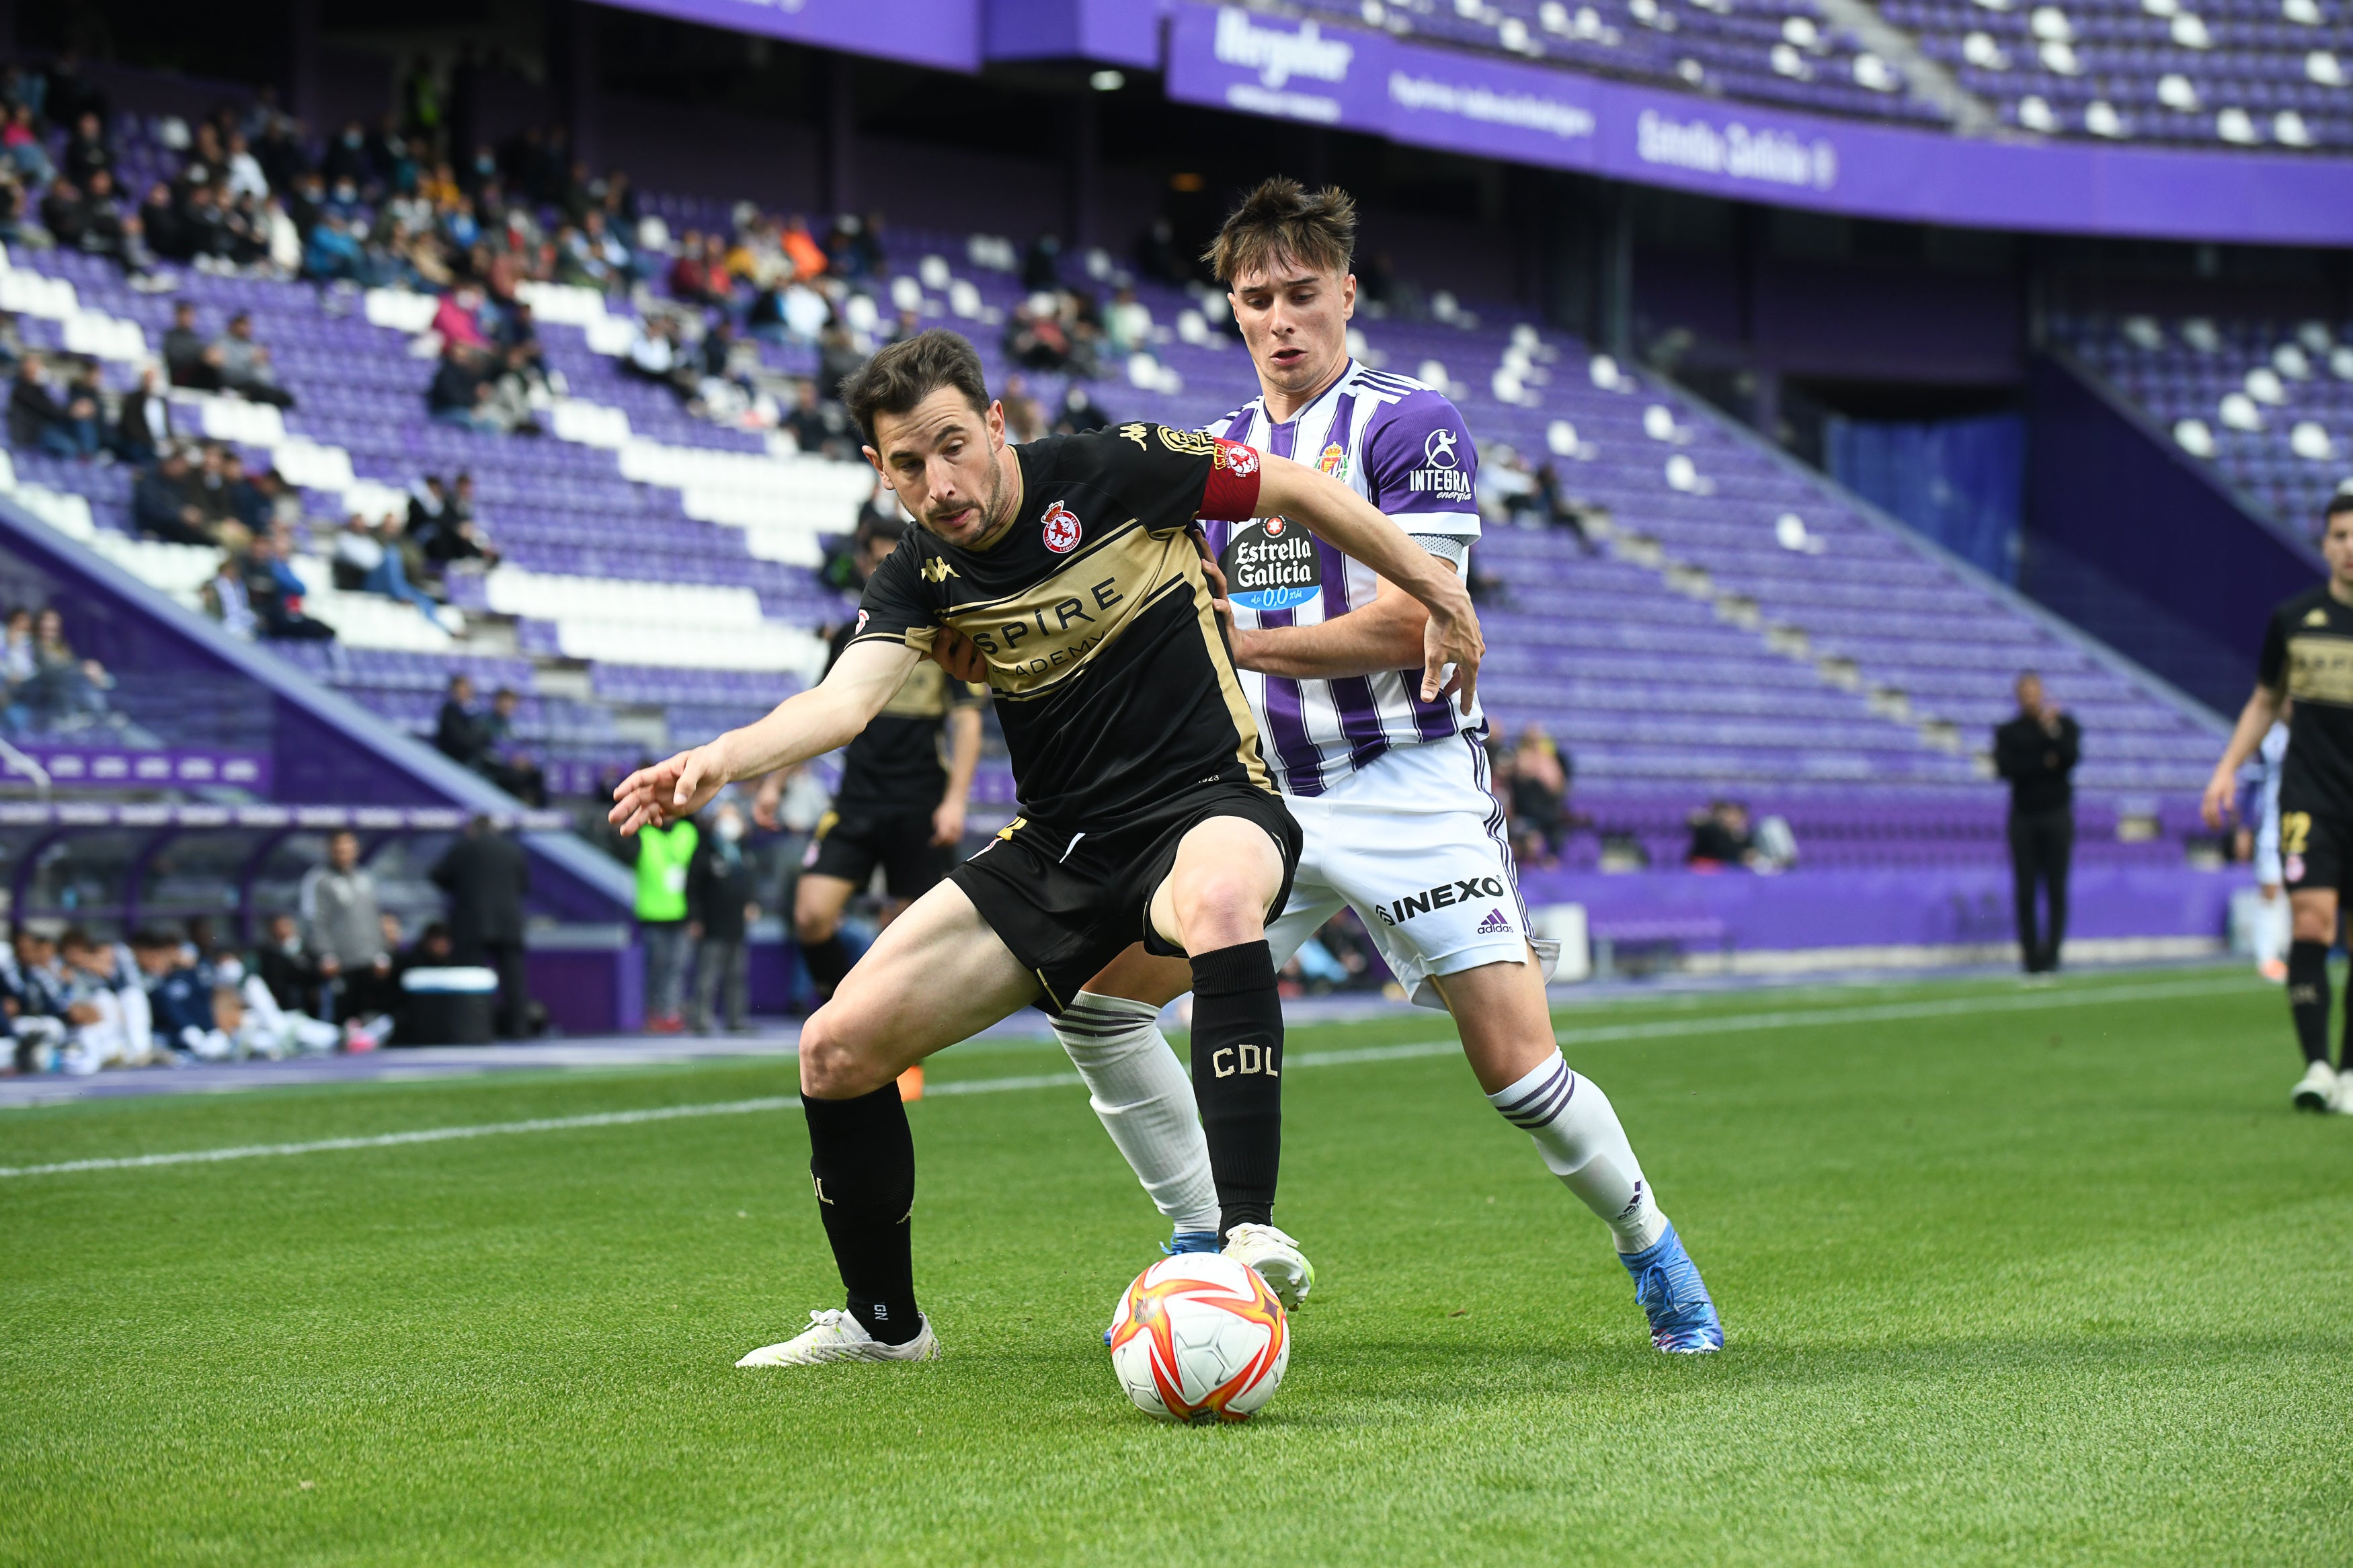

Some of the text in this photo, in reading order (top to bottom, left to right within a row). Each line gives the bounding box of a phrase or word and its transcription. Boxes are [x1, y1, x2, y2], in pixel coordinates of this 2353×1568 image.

[1410, 469, 1471, 493] INTEGRA
[1060, 538, 1078, 552] LEONESA
[1235, 537, 1312, 565] Estrella
[1238, 561, 1312, 587] Galicia
[1263, 585, 1288, 607] 0,0
[972, 576, 1124, 655] SPIRE
[1198, 774, 1220, 784] 23
[1392, 876, 1504, 923] INEXO
[1477, 923, 1514, 934] adidas
[1212, 1044, 1278, 1078] CDL
[809, 1169, 834, 1205] L
[874, 1302, 889, 1320] GN
